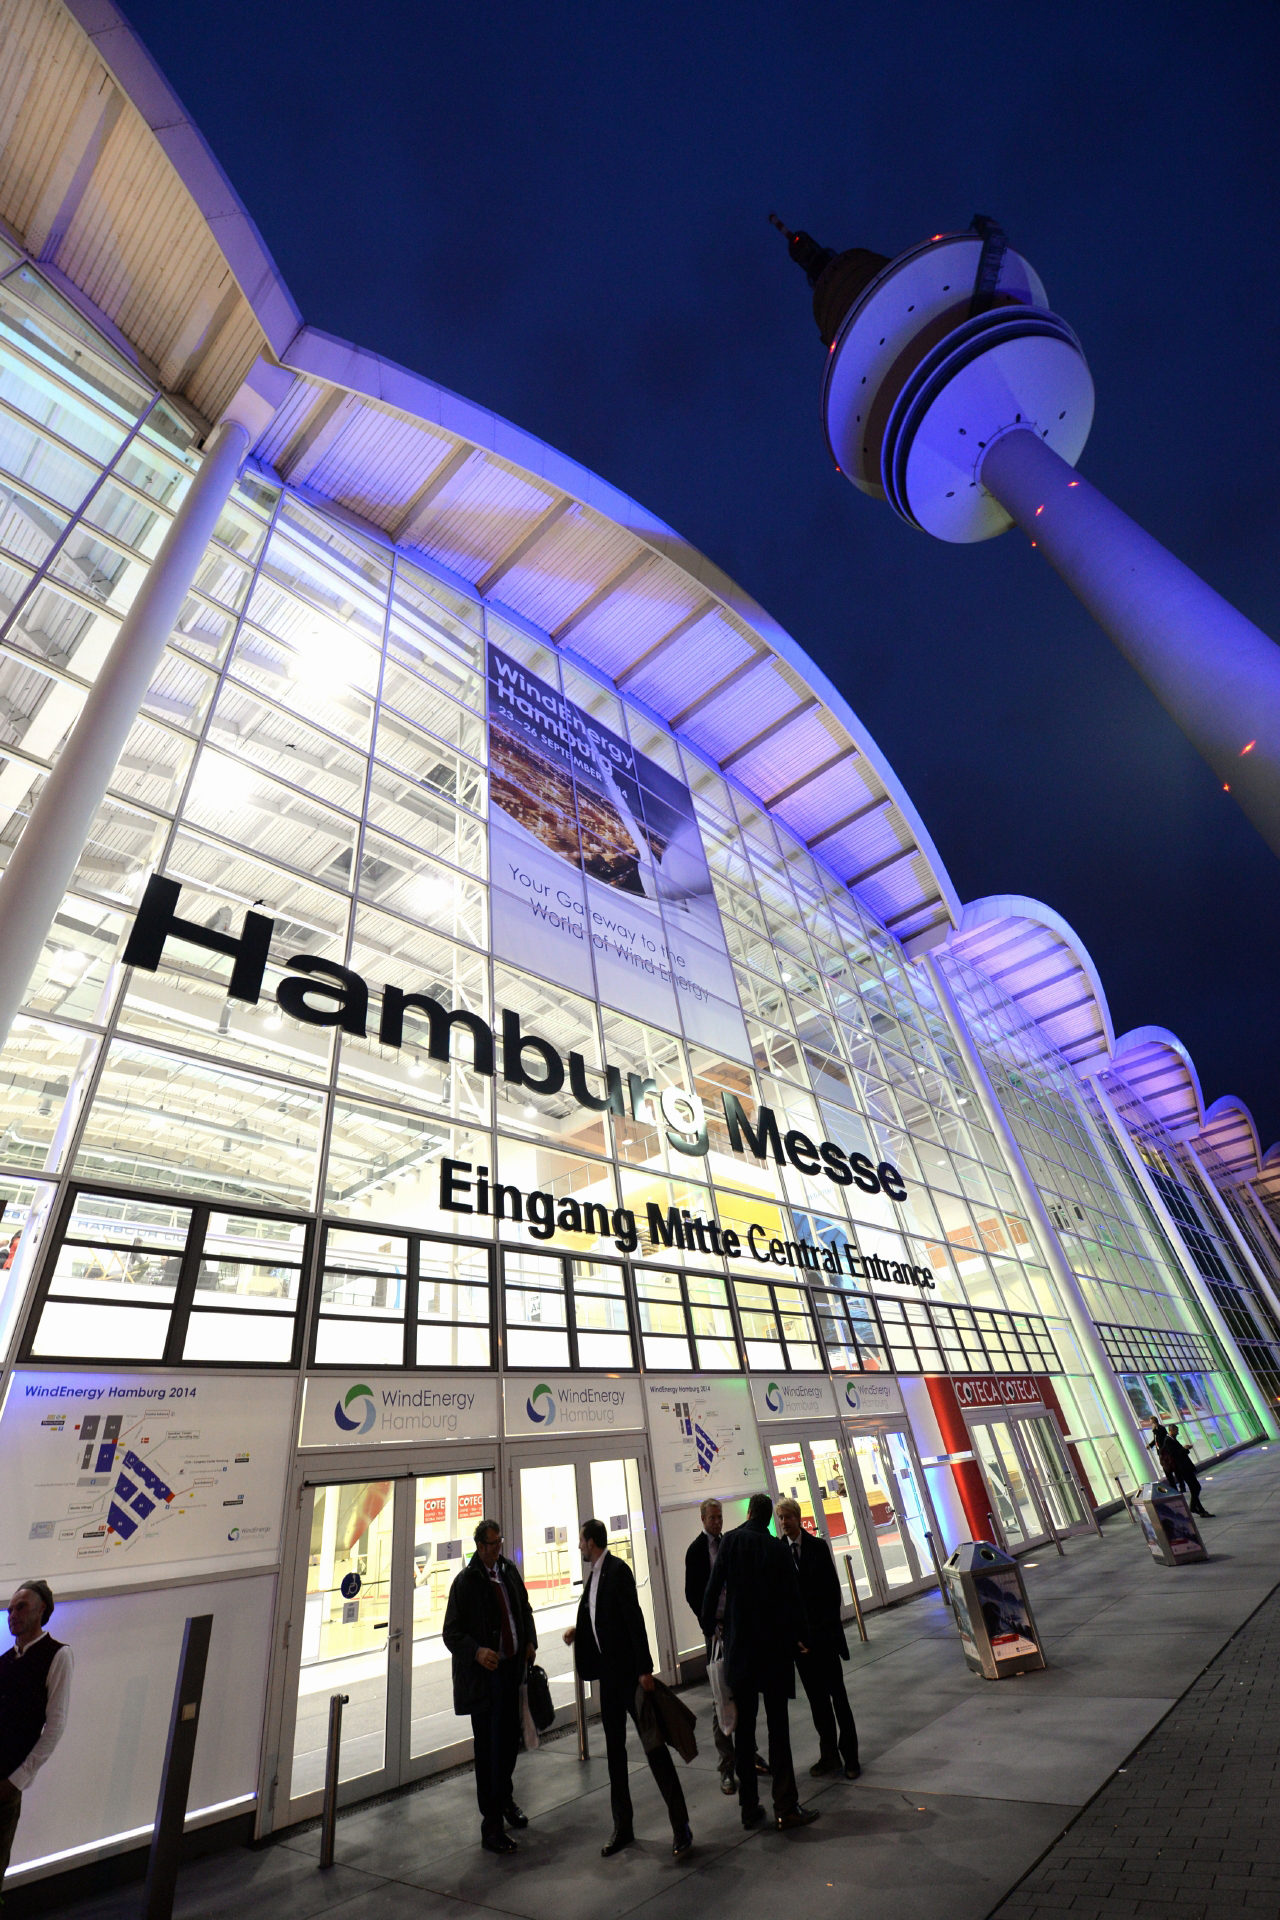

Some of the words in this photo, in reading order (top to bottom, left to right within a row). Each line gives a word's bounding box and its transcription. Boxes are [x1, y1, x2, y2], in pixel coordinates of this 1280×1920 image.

[494, 655, 634, 770] WindEnergy
[497, 678, 614, 777] Hamburg
[540, 732, 602, 782] SEPTEMBER
[508, 863, 551, 897] Your
[556, 890, 636, 944] Gaeway
[641, 931, 657, 954] to
[660, 943, 687, 968] the
[529, 898, 584, 941] World
[592, 930, 610, 950] of
[612, 942, 655, 977] Wind
[659, 962, 711, 1003] Energy
[122, 873, 710, 1157] Hamburg
[720, 1091, 908, 1202] Messe
[440, 1157, 638, 1253] Eingang
[646, 1202, 741, 1258] Mitte
[747, 1223, 844, 1276] Central
[843, 1243, 936, 1289] Entrance
[25, 1386, 105, 1400] WindEnergy
[108, 1387, 166, 1400] Hamburg
[169, 1387, 197, 1398] 2014
[382, 1390, 475, 1409] WindEnergy
[558, 1388, 625, 1405] WindEnergy
[650, 1386, 678, 1394] WindEnergy
[782, 1385, 822, 1399] WindEnergy
[857, 1385, 891, 1397] WindEnergy
[955, 1381, 1001, 1404] COTECA
[1000, 1380, 1040, 1401] COTECA
[559, 1407, 614, 1424] Hamburg
[785, 1401, 819, 1413] Hamburg
[381, 1412, 458, 1431] Hamburg
